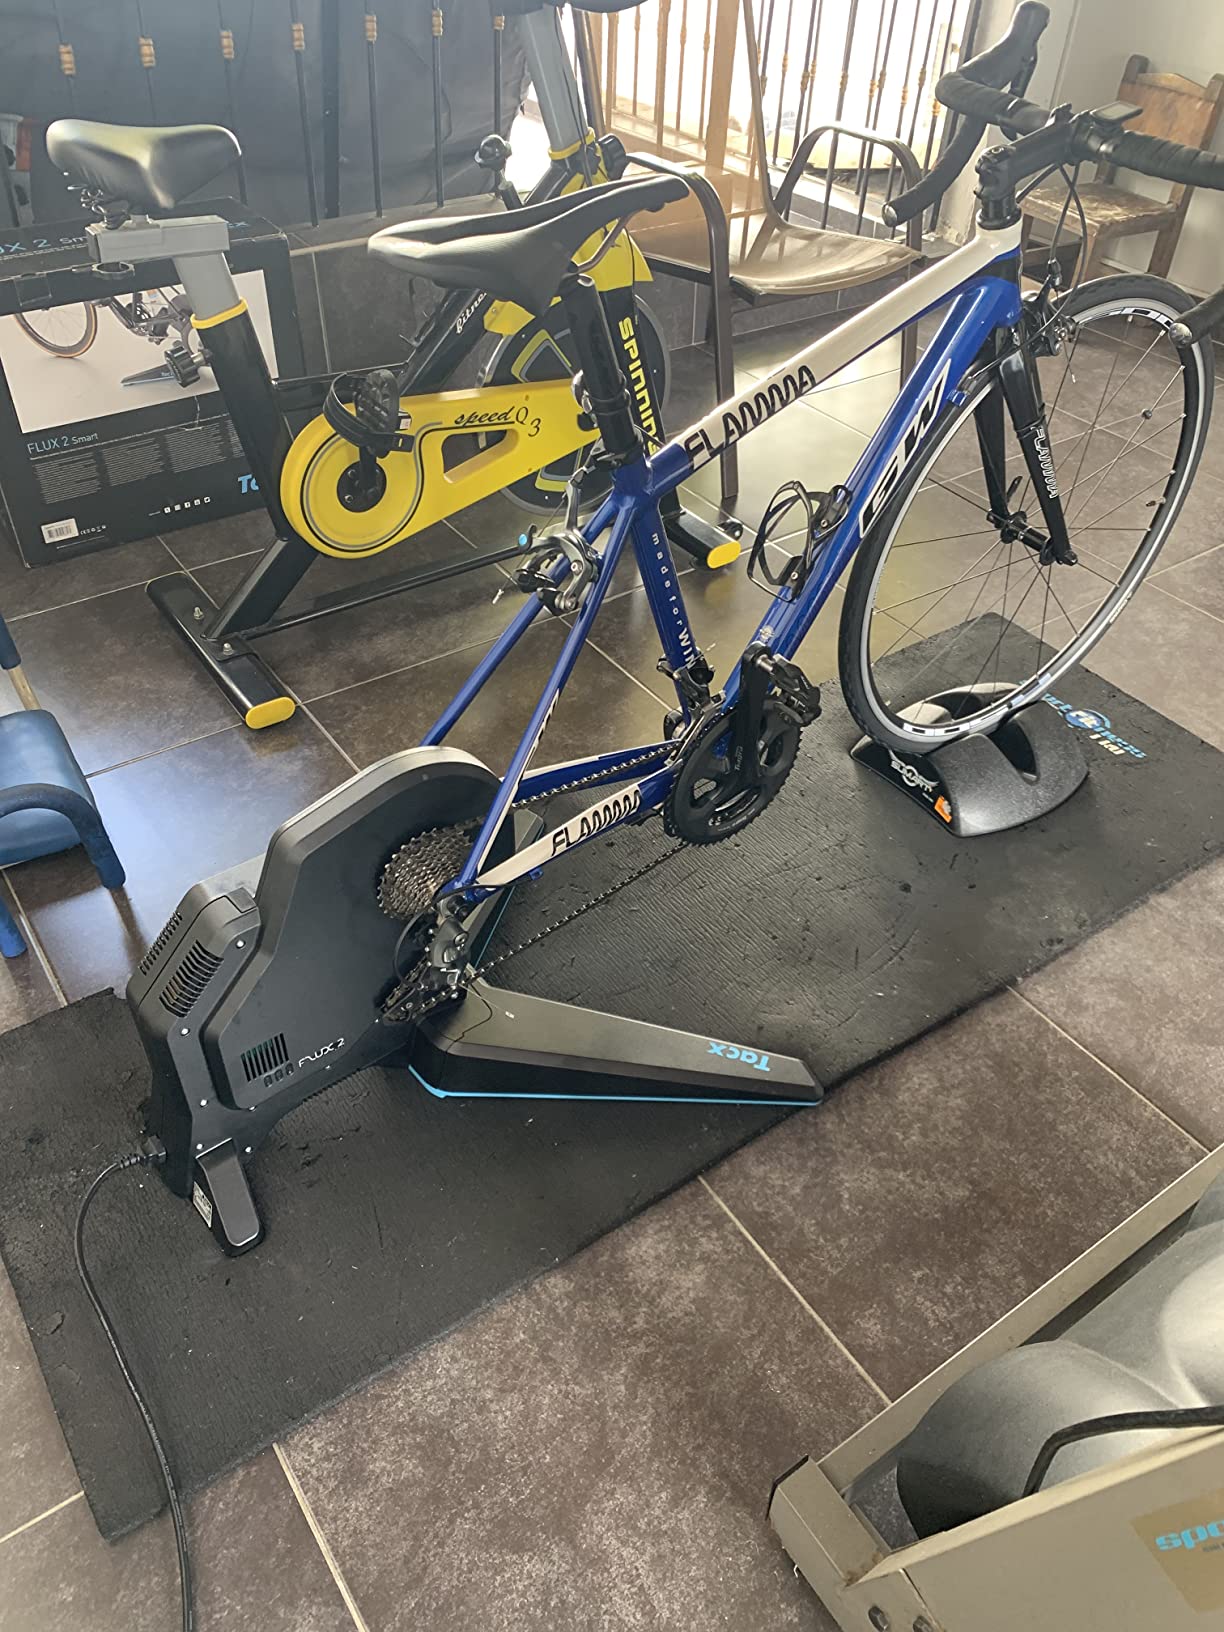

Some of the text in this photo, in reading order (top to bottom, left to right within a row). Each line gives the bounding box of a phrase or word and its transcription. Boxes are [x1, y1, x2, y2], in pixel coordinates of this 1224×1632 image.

[33, 239, 51, 248] 2
[683, 364, 817, 468] FLAMMA
[27, 432, 98, 454] FLUX 2 Smart
[298, 1037, 345, 1068] FLUX 2
[707, 1041, 771, 1072] Tacx
